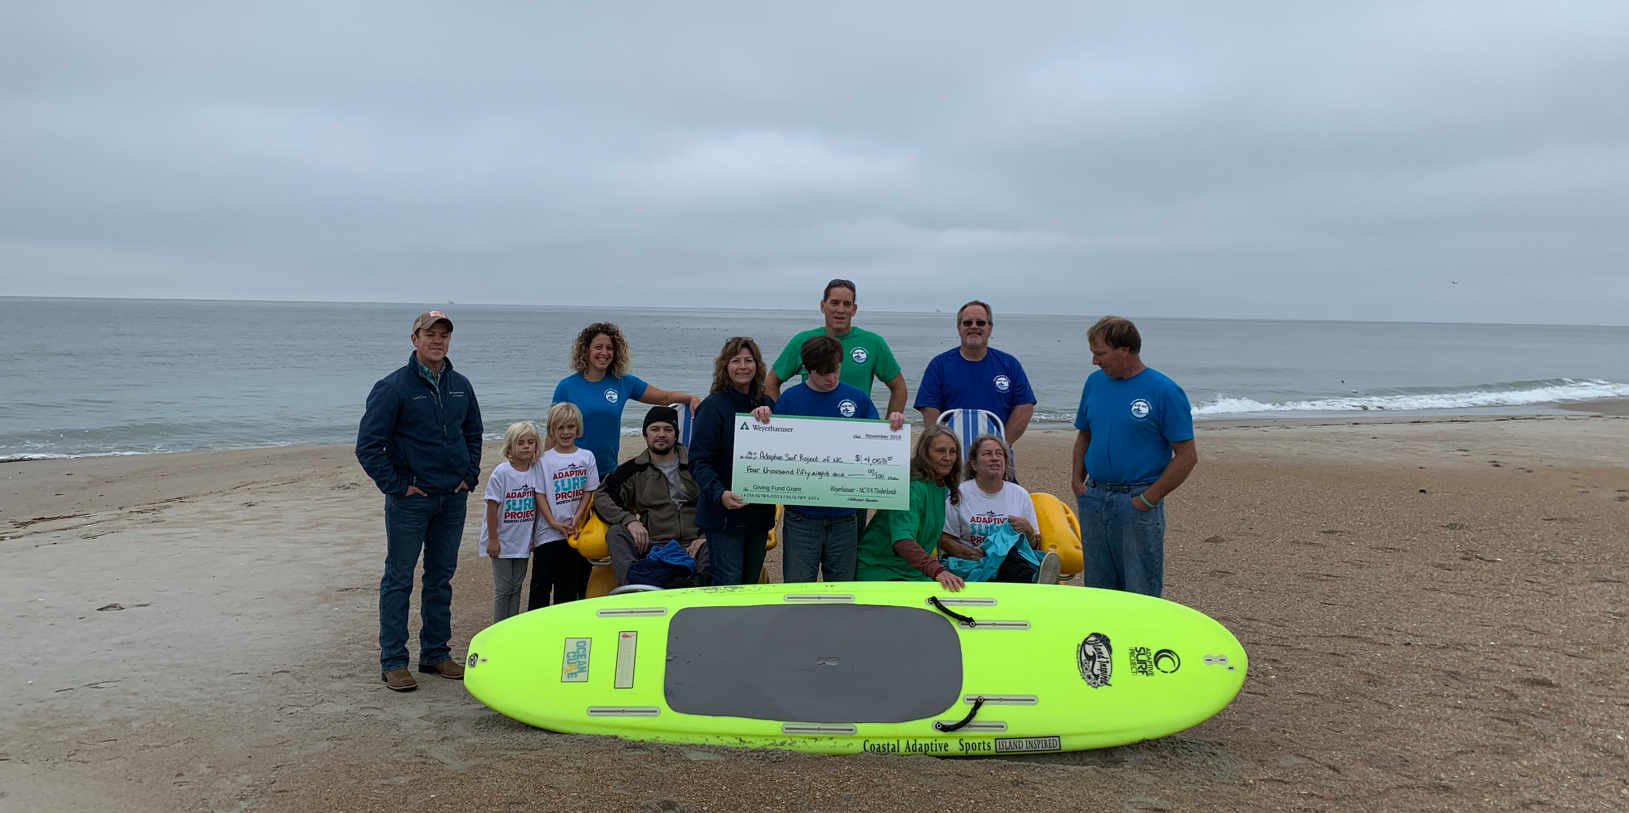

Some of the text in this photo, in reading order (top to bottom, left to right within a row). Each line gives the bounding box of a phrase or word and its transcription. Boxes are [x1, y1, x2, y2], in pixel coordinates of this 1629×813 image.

[752, 424, 794, 433] Weyerhaeuser
[785, 453, 798, 461] Surf
[799, 453, 819, 464] Project
[553, 469, 588, 480] ADAPTIVE
[746, 465, 760, 473] Four
[763, 466, 794, 475] thousand
[752, 484, 770, 492] Giving
[555, 489, 583, 500] PROJEC
[504, 509, 535, 519] PROJEC
[970, 516, 1007, 524] ADAPTIV
[576, 640, 587, 673] OCEAN
[1135, 646, 1149, 677] SURF
[1145, 647, 1154, 677] ADAPTIVE
[863, 737, 1058, 756] Coastal Adaptive Sports ISLAND INSPIRED
